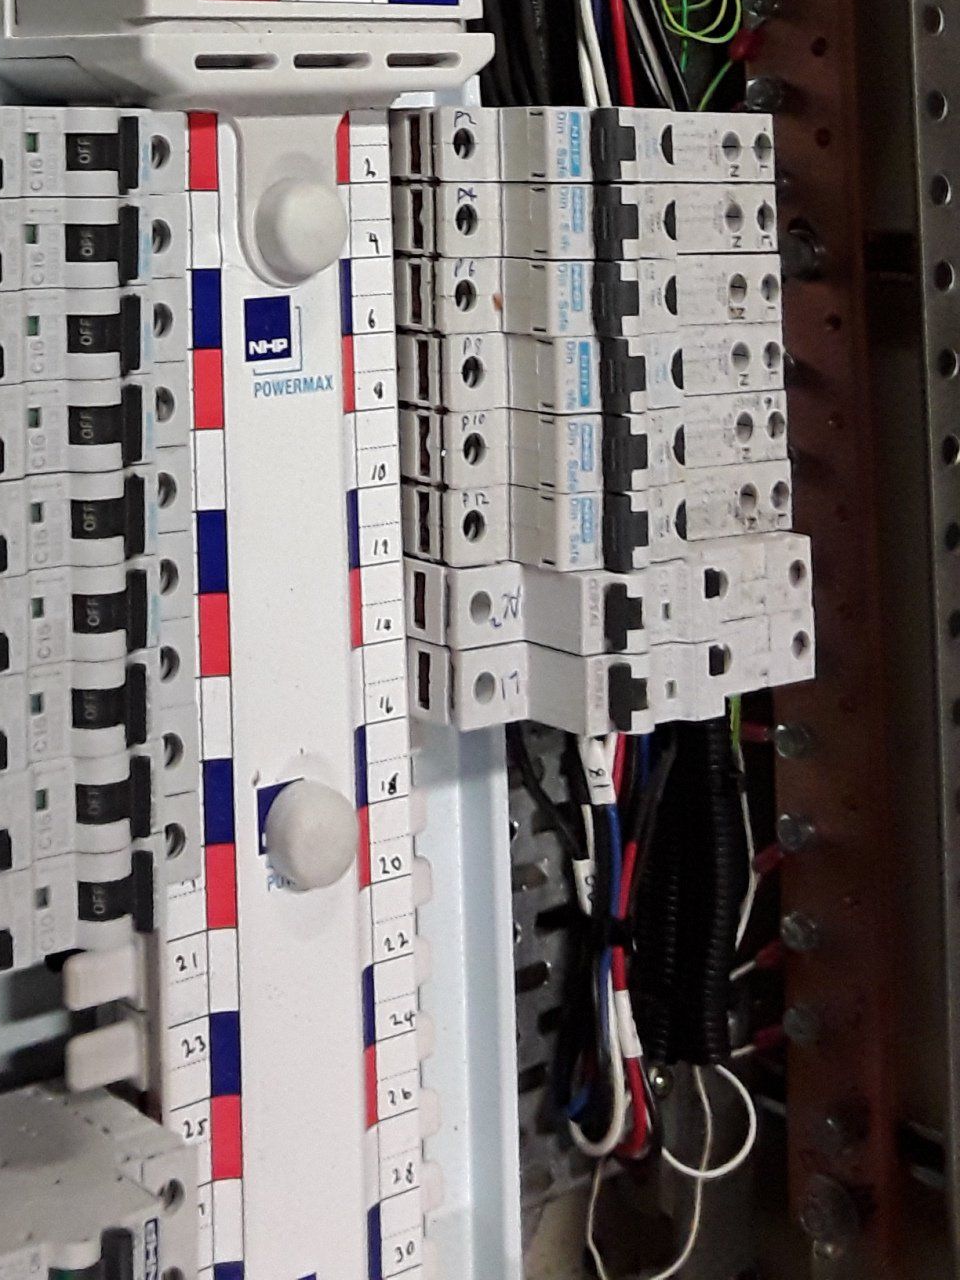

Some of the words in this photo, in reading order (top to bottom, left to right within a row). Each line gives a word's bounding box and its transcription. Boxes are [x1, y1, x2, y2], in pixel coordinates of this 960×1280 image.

[77, 137, 91, 164] OFF
[80, 229, 94, 257] OFF
[368, 231, 380, 254] 4
[368, 308, 376, 328] 6
[79, 317, 93, 346] OFF
[248, 338, 288, 355] NHP
[253, 375, 334, 398] POWERMAX
[81, 412, 94, 440] OFF
[83, 503, 96, 532] OFF
[87, 600, 100, 627] OFF
[379, 855, 402, 875] 20
[93, 886, 109, 915] OFF
[384, 932, 409, 952] 22
[175, 951, 198, 972] 21
[390, 1011, 416, 1027] 24
[181, 1035, 207, 1058] 23
[183, 1118, 208, 1140] 25
[392, 1161, 414, 1184] 28
[394, 1240, 415, 1264] 30
